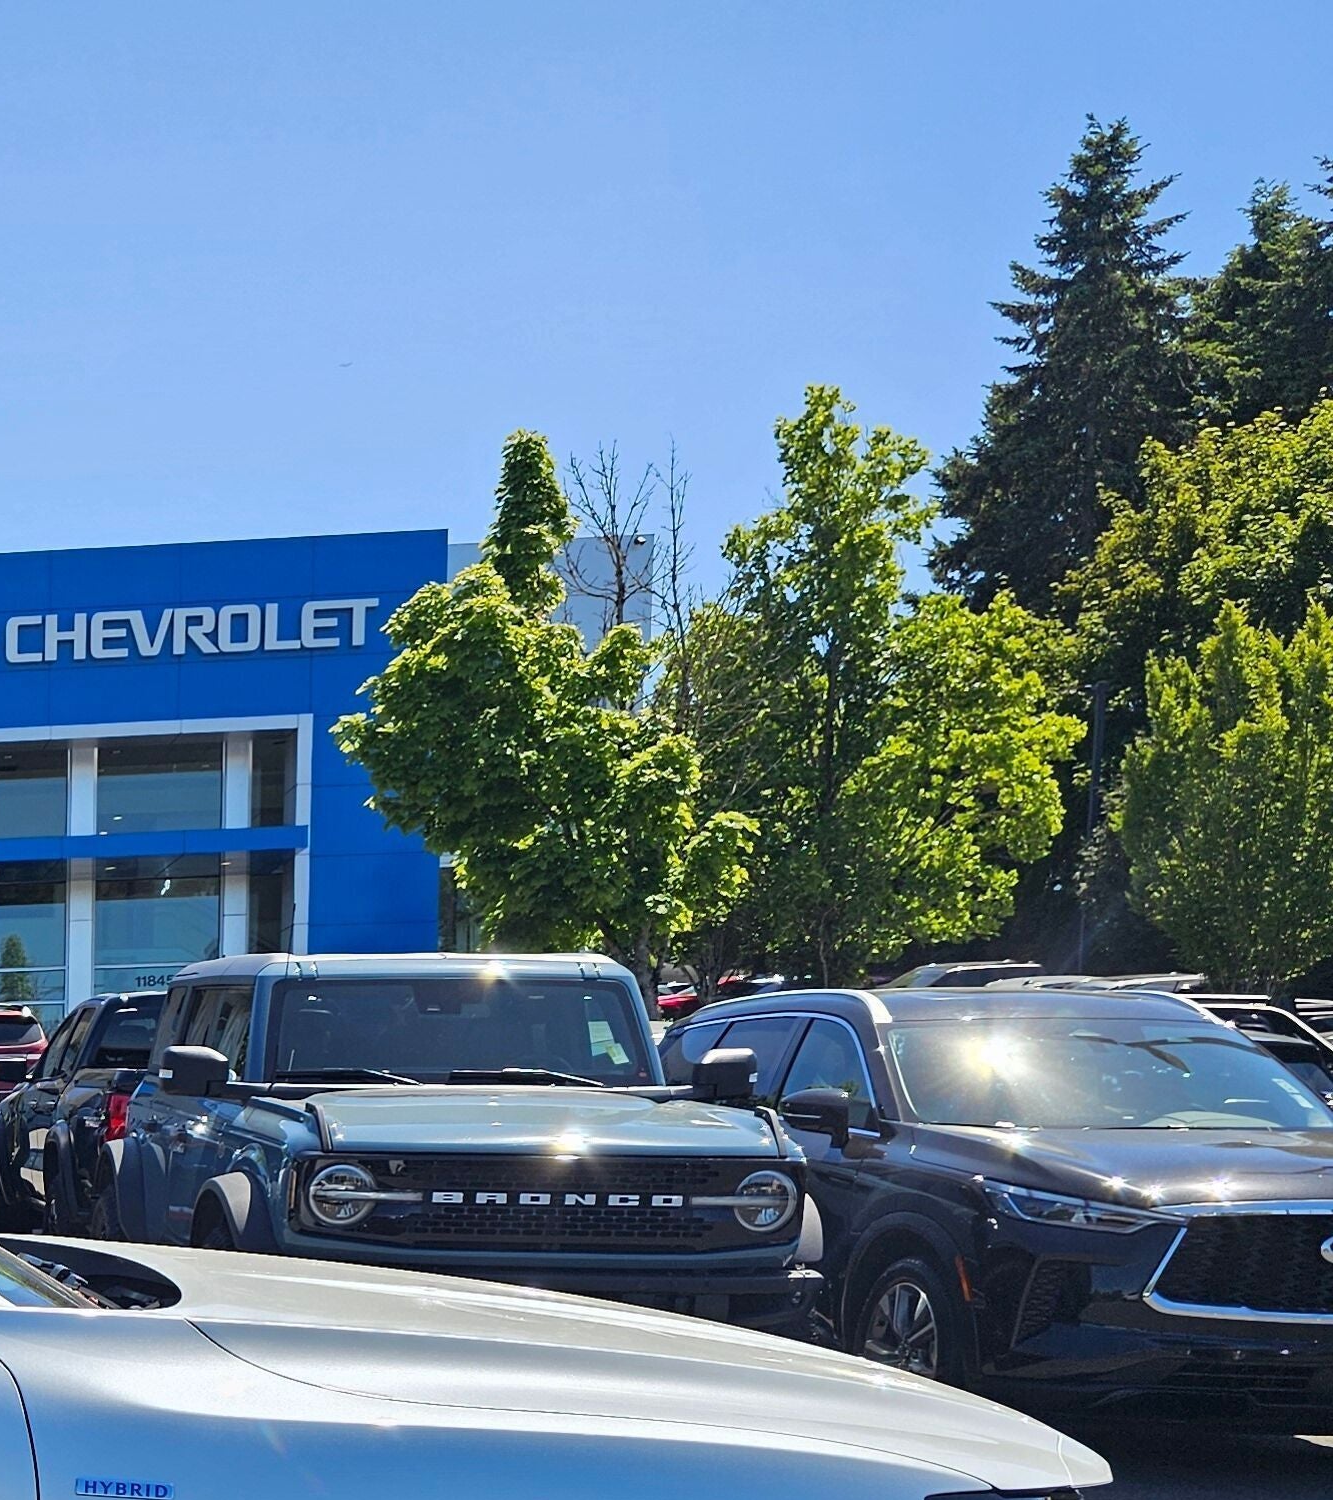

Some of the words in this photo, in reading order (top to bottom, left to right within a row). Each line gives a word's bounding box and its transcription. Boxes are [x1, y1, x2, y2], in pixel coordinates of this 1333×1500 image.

[5, 598, 380, 664] CHEVROLET
[431, 1191, 684, 1207] BRONCO
[84, 1480, 169, 1499] HYBRID
